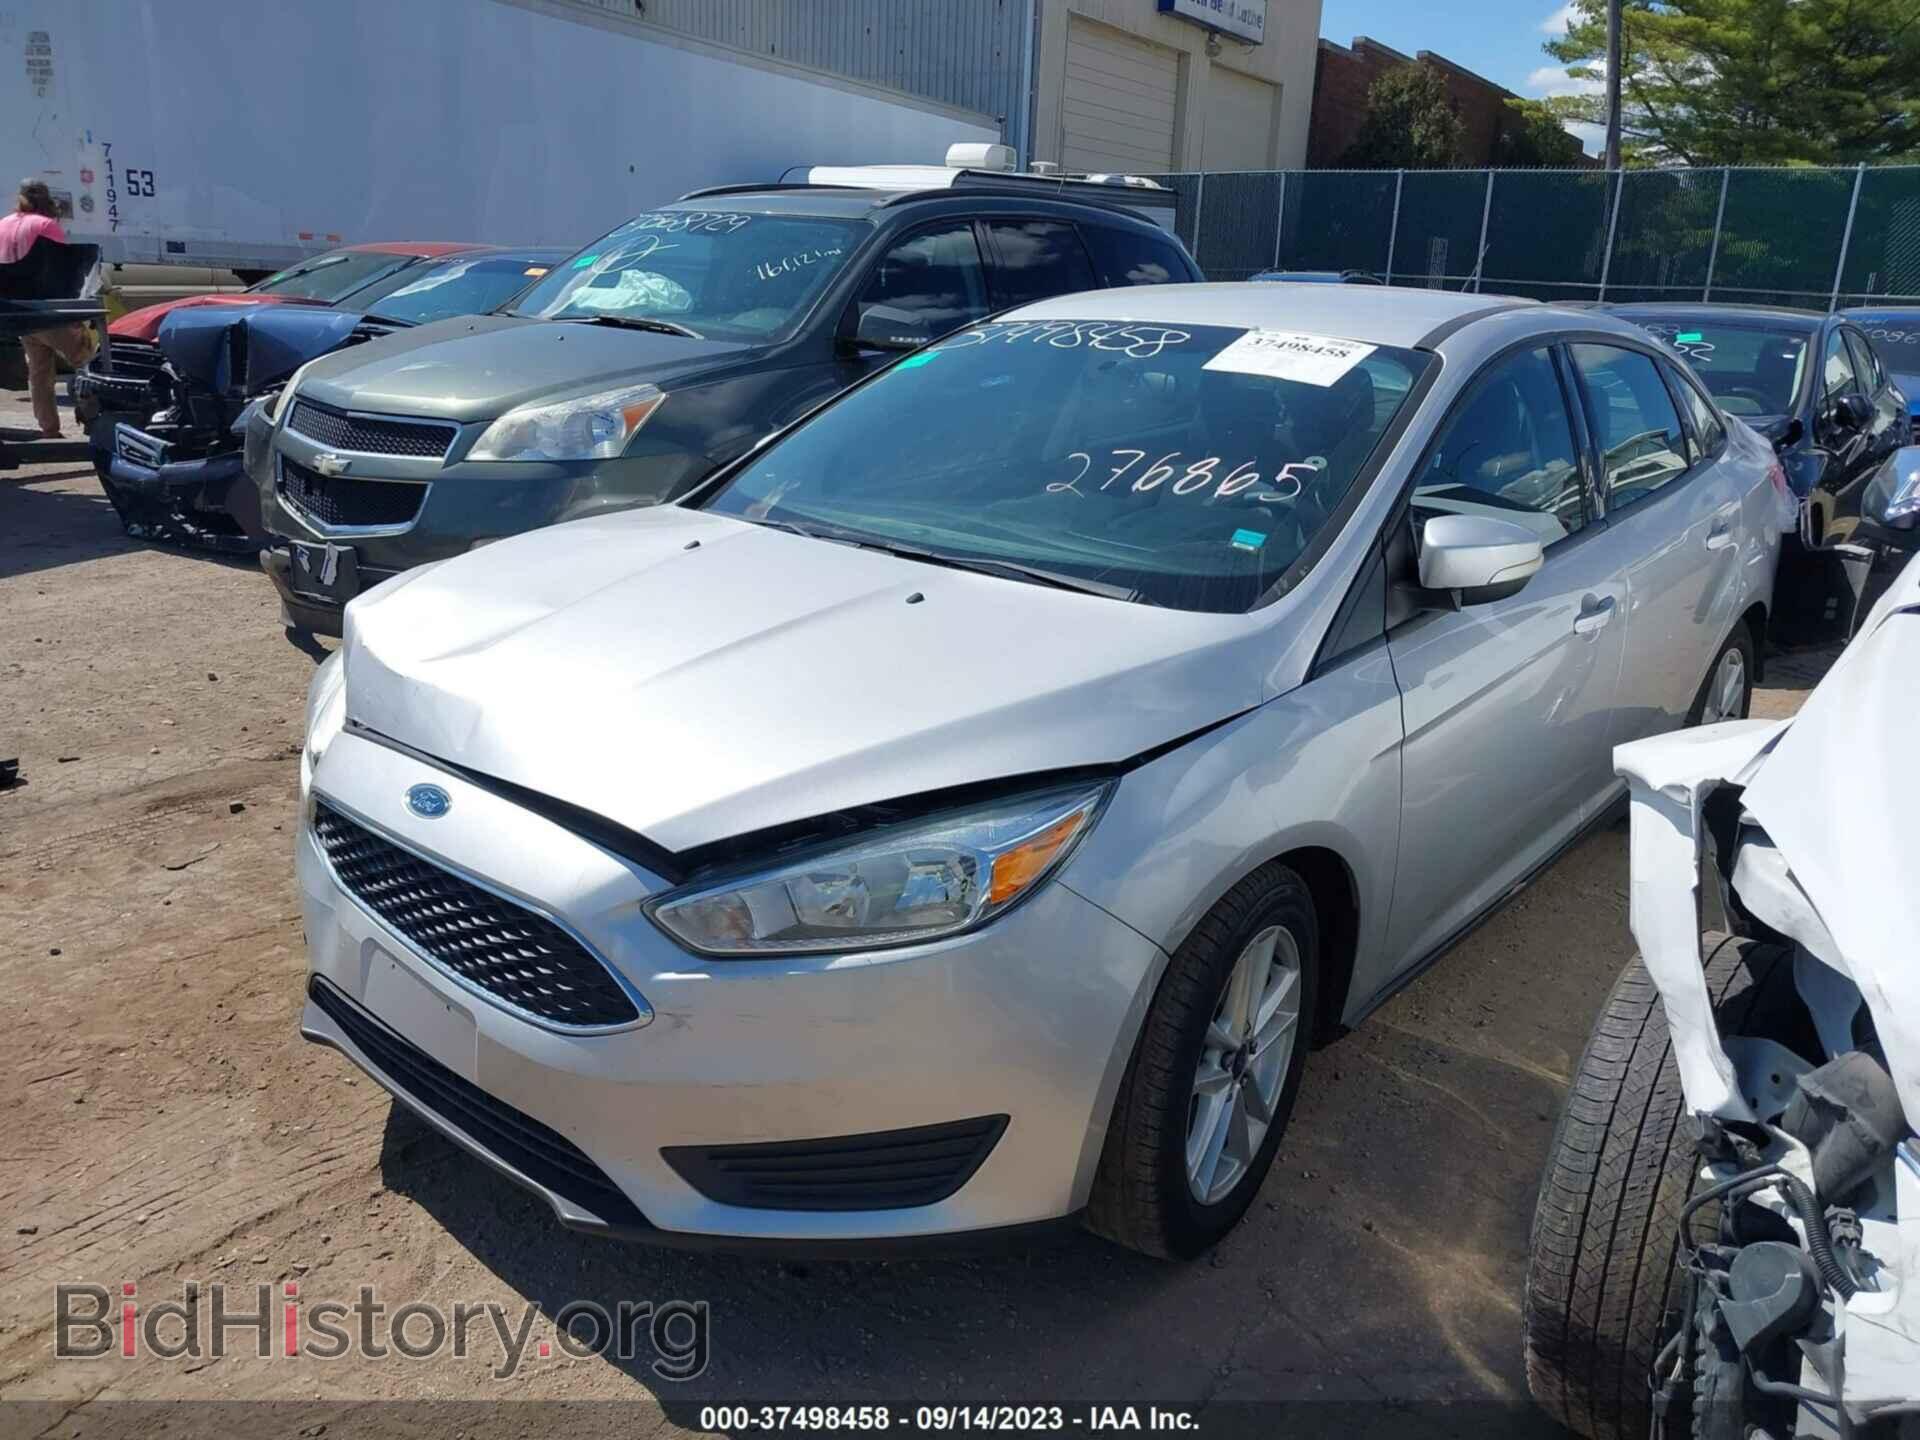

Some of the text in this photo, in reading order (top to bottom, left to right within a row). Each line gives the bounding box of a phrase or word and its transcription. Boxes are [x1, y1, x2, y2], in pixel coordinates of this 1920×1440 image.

[126, 169, 155, 197] 53
[1247, 337, 1352, 359] 37498458
[1046, 449, 1319, 502] 276865
